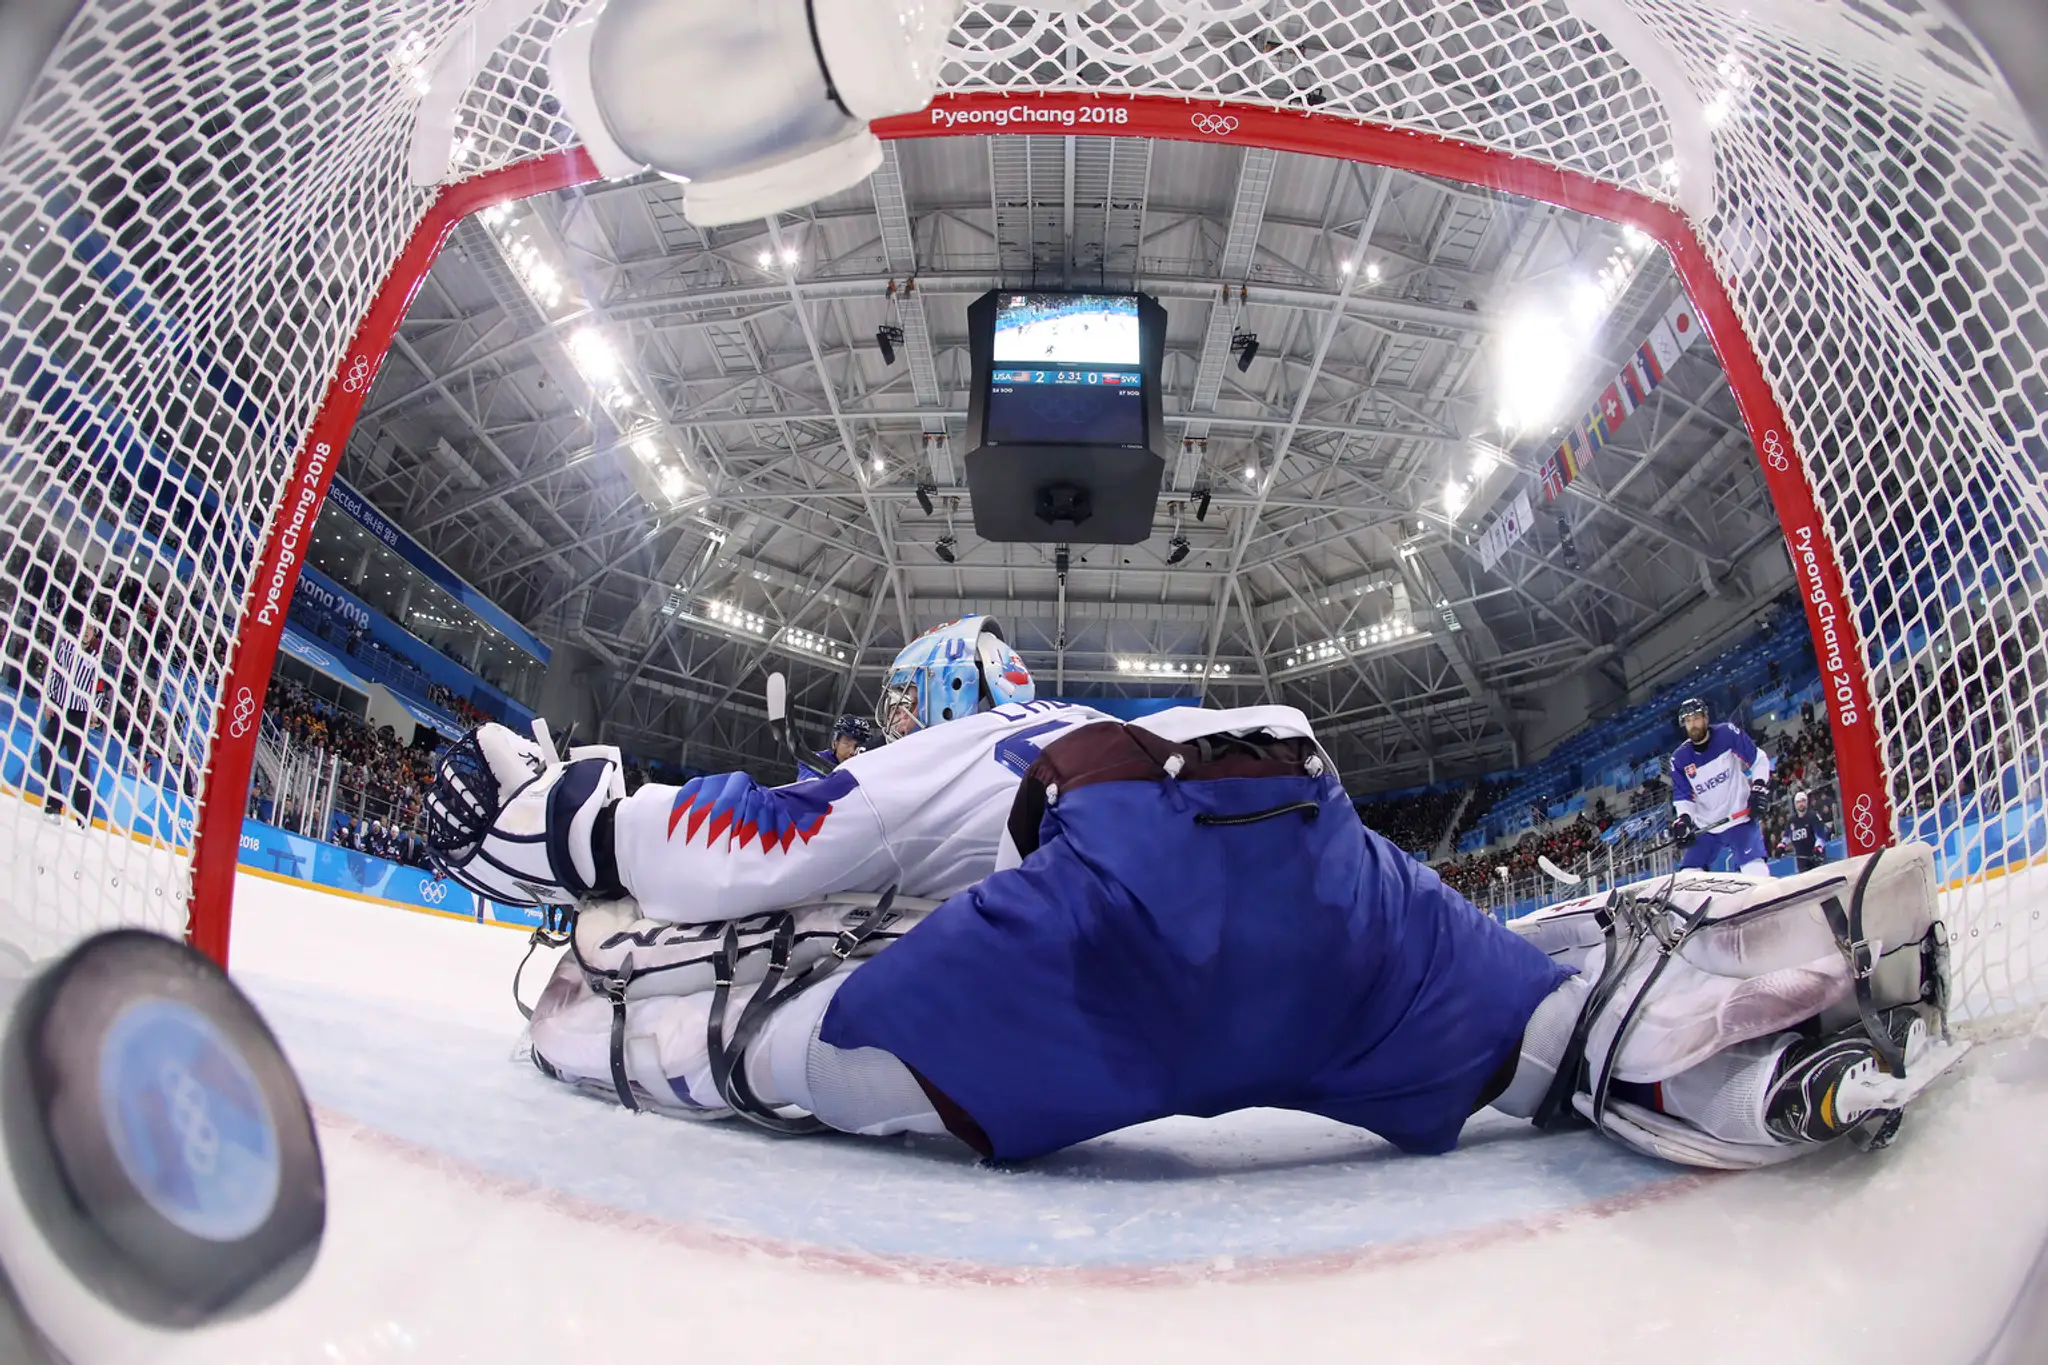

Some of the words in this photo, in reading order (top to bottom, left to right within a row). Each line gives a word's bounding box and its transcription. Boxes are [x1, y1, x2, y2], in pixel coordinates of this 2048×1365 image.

[931, 106, 1075, 126] PyeongChang
[1079, 106, 1128, 124] 2018
[993, 373, 1012, 381] USA
[1035, 371, 1045, 383] 2
[1088, 372, 1098, 384] 0
[1121, 375, 1138, 384] SVK
[329, 484, 362, 518] nected.
[257, 489, 316, 626] PyeongChang
[304, 442, 331, 487] 2018
[334, 596, 369, 629] 2018
[1796, 526, 1842, 672] PyeongChang
[1833, 672, 1857, 727] 2018
[1792, 828, 1807, 841] USA
